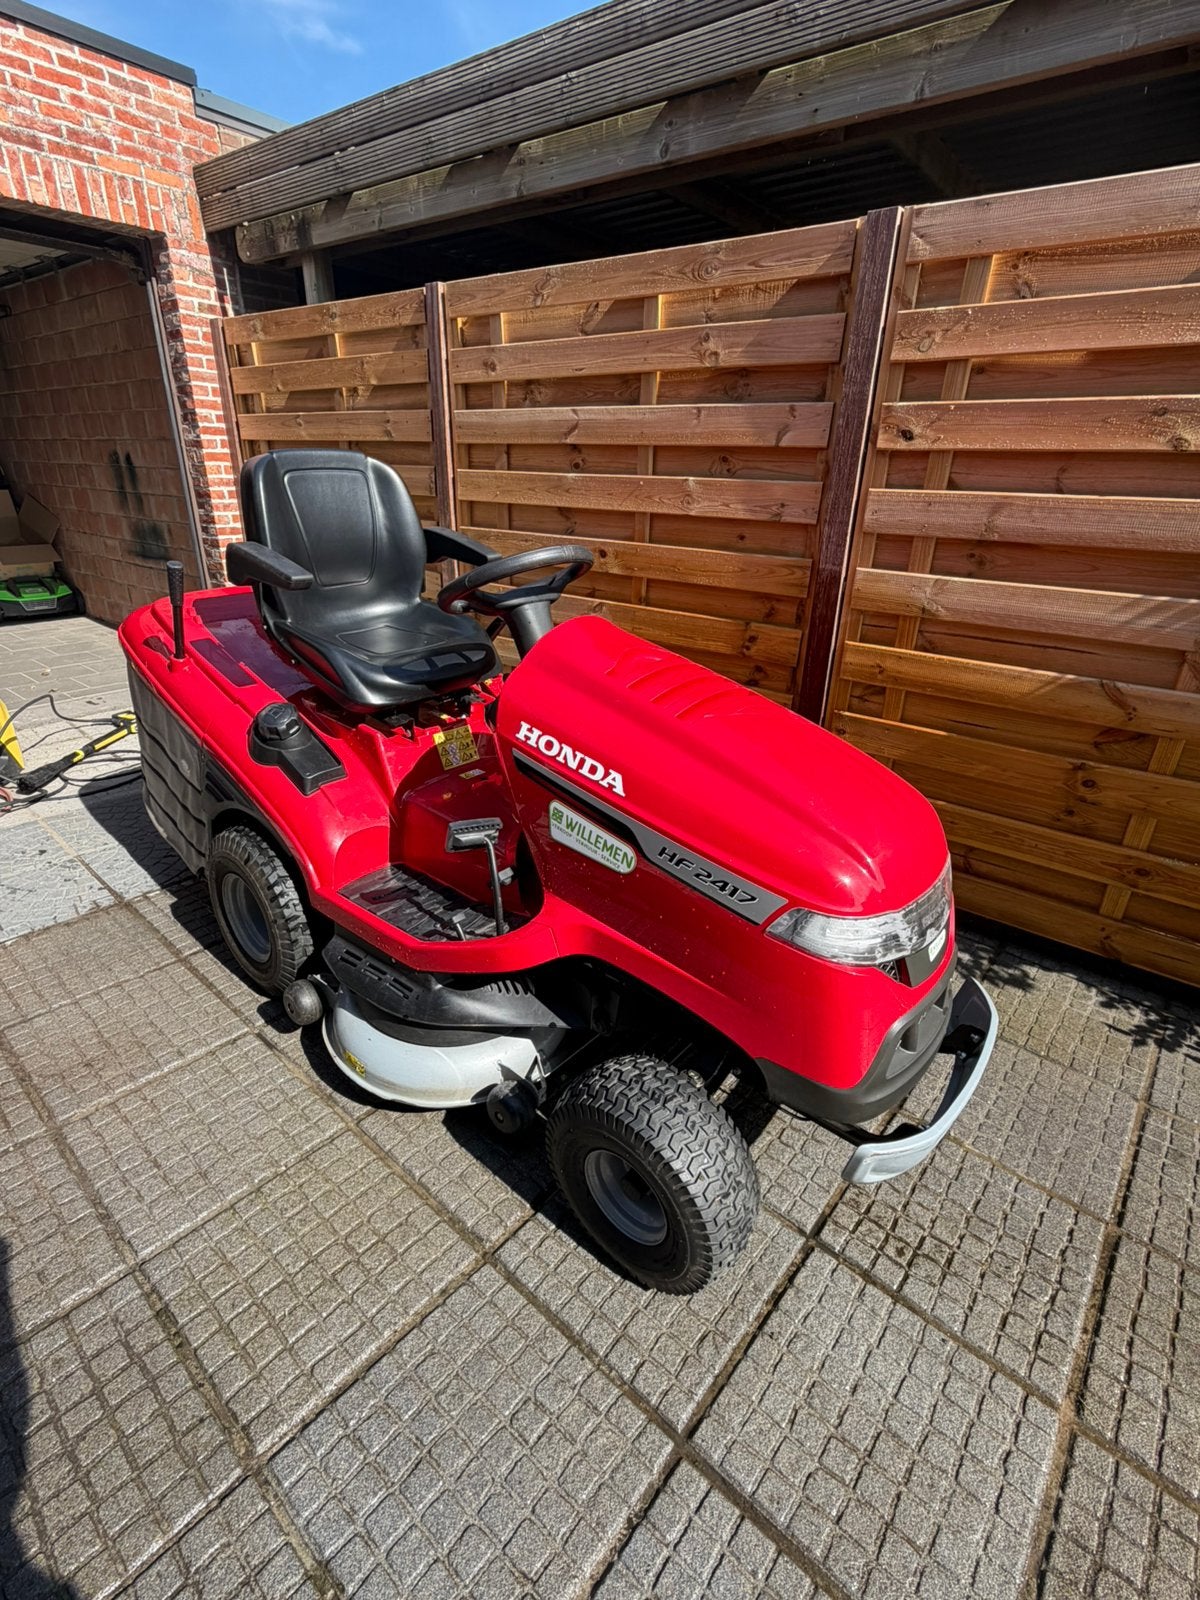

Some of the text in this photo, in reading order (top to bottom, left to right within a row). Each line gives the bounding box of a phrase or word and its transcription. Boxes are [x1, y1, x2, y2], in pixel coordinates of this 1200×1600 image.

[515, 720, 626, 798] HONDA
[565, 814, 634, 869] WILLEMEN
[601, 854, 621, 869] SERVICE
[657, 846, 759, 904] HF 2417
